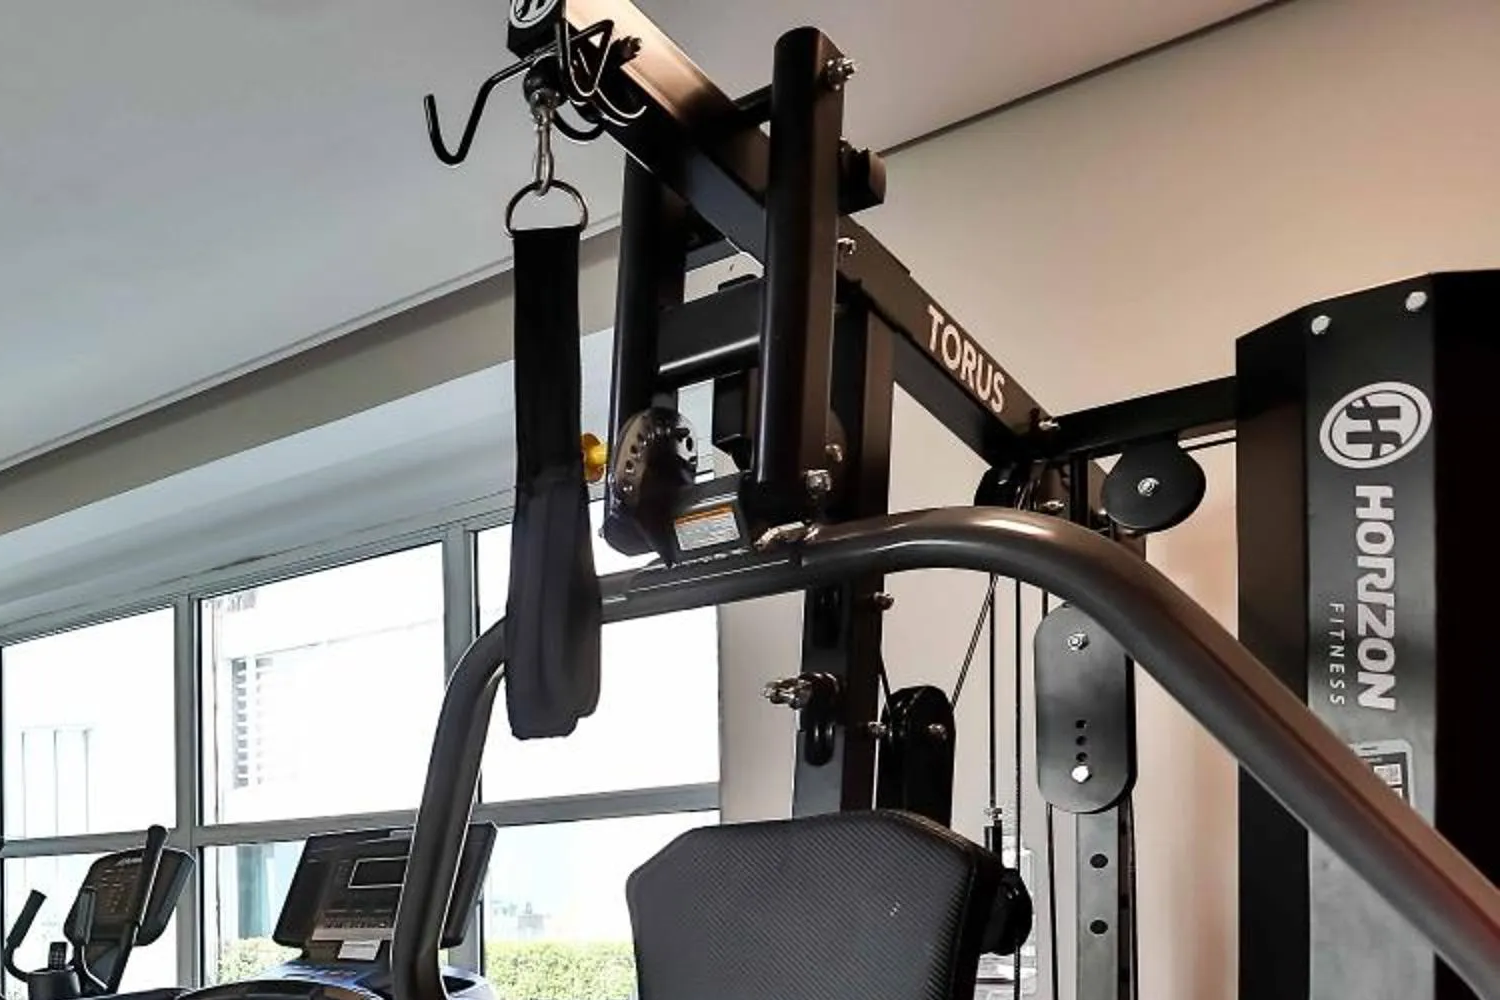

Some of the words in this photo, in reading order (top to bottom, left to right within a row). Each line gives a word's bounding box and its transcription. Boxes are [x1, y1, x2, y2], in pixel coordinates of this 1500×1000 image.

[927, 304, 1005, 413] TORUS
[1355, 485, 1396, 711] HORIZON
[1329, 603, 1345, 705] FITNESS
